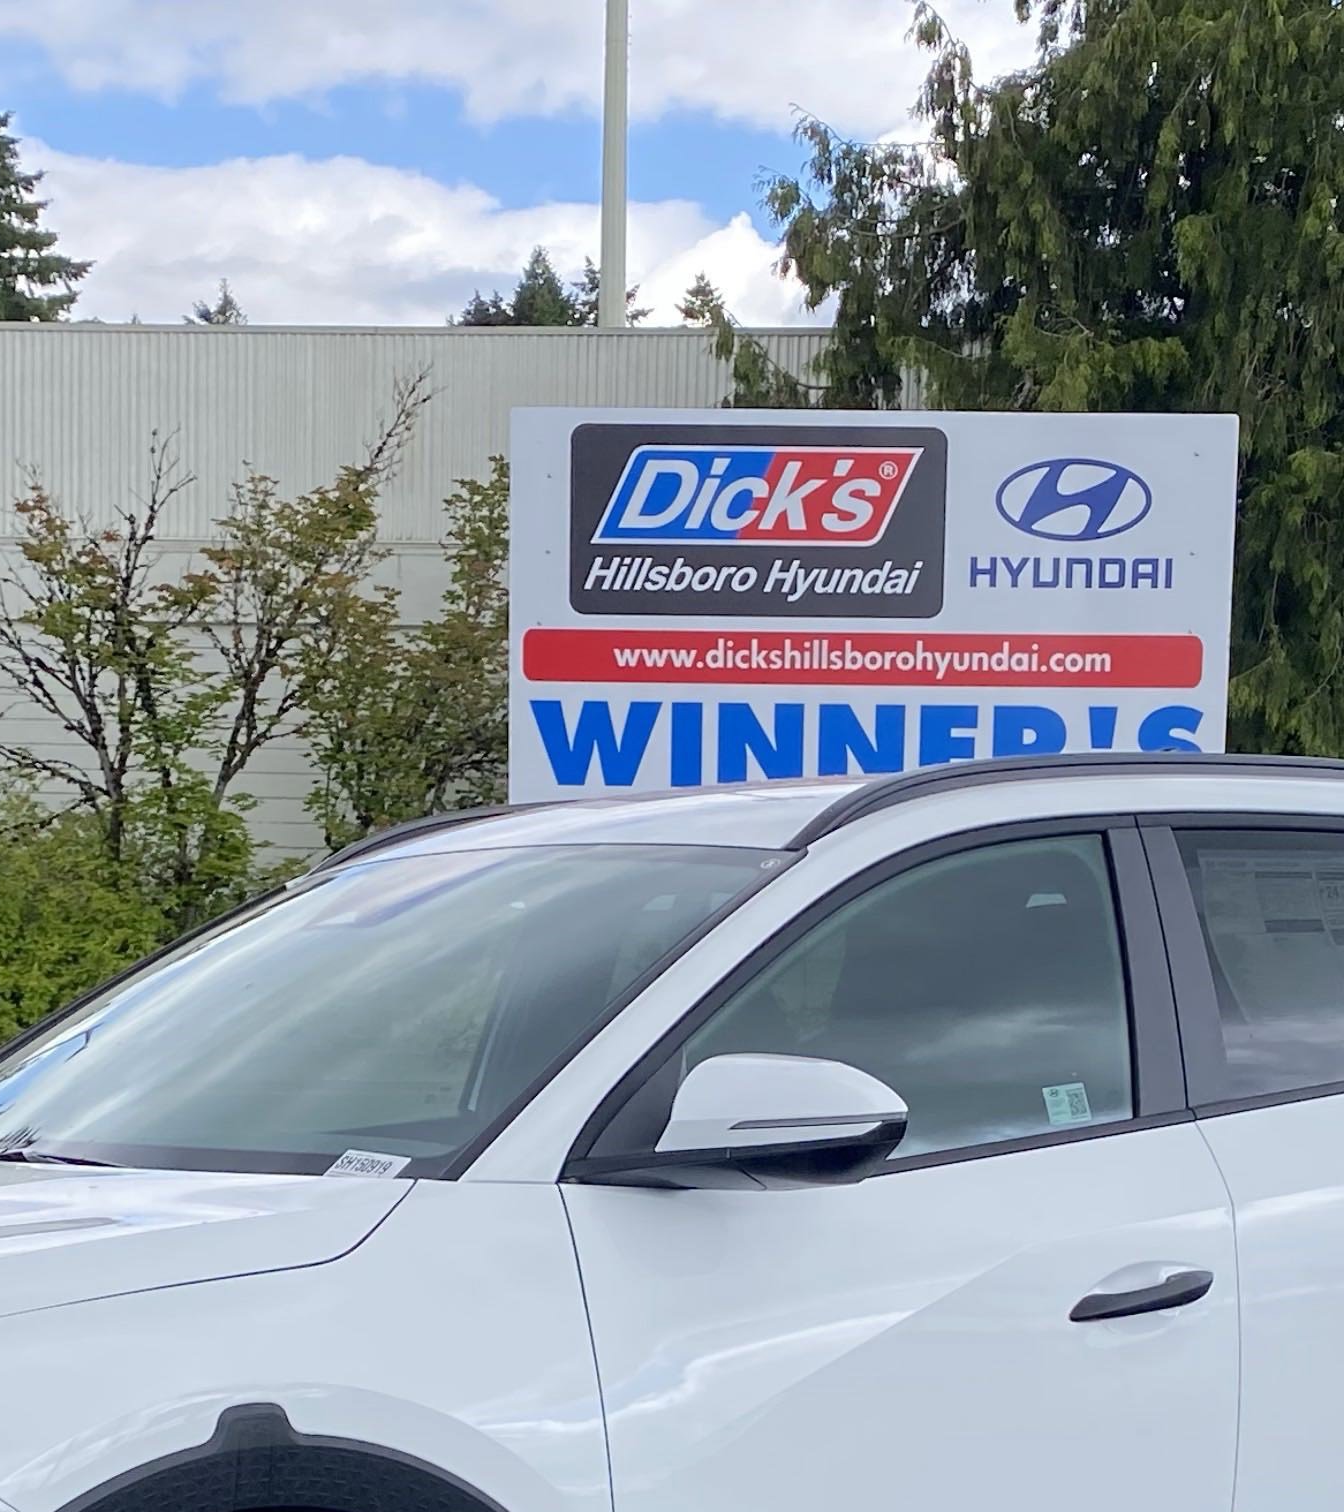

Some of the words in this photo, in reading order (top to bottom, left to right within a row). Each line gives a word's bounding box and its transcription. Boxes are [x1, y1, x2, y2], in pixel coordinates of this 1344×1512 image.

[617, 457, 881, 533] Dick's
[583, 556, 758, 593] Hillsboro
[762, 559, 924, 602] Hyundai
[969, 555, 1173, 591] HYUNDAI
[612, 637, 1112, 683] www.dickshillsborohyundai.com
